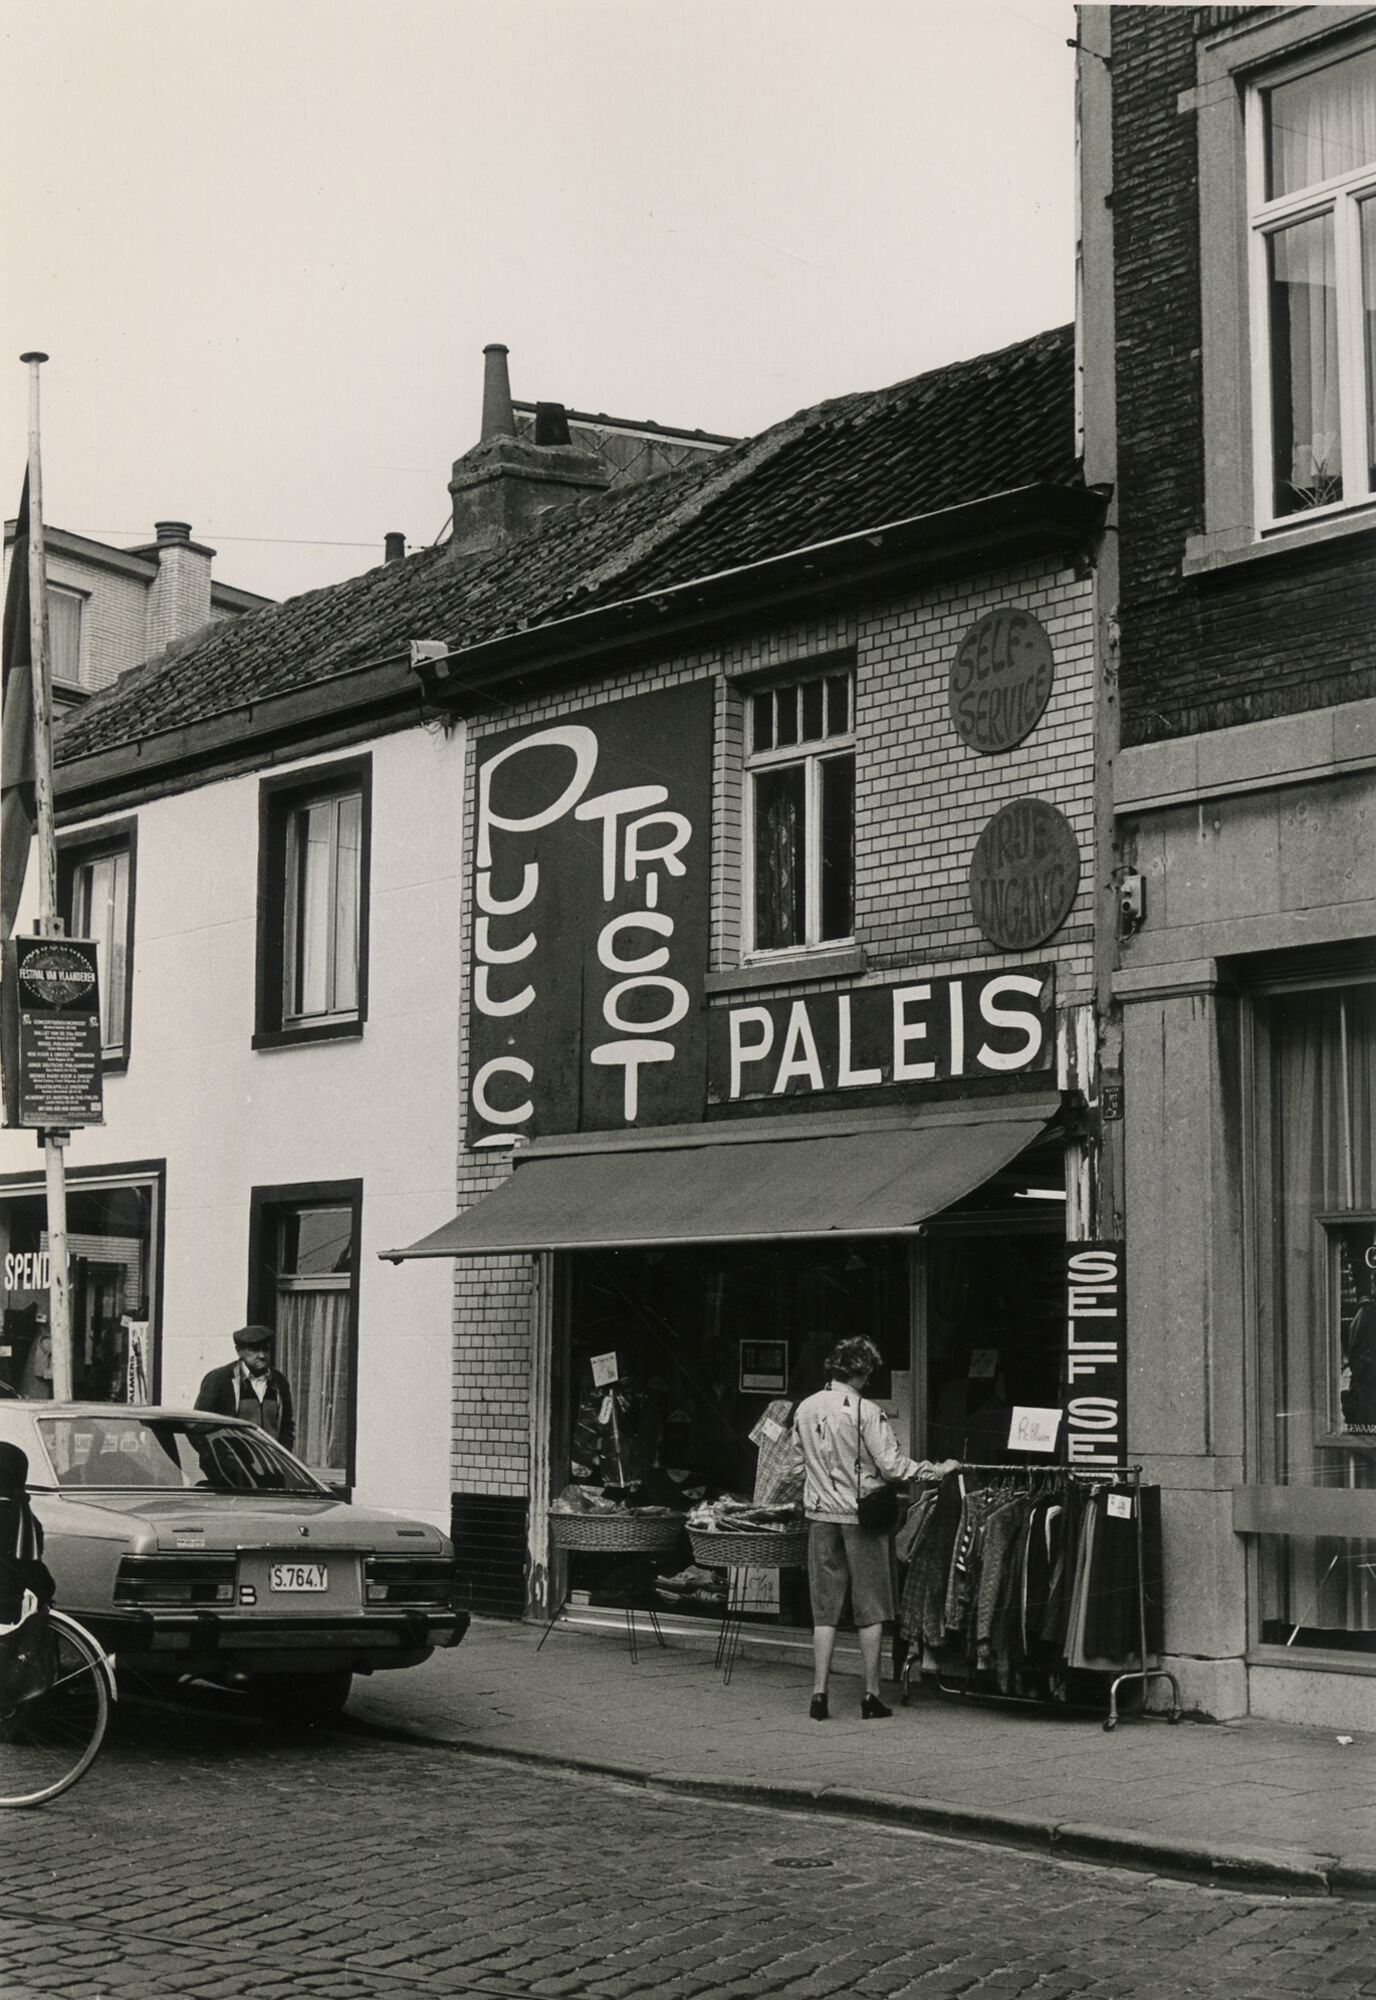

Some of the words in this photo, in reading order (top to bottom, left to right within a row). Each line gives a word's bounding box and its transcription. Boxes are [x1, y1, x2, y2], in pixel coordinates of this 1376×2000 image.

[474, 724, 599, 1018] PULL
[19, 968, 45, 980] FESTIVAL
[45, 969, 58, 981] VAN
[58, 970, 96, 983] VLAANDEREN
[574, 784, 693, 1122] TRICOT
[729, 973, 1044, 1099] PALEIS
[4, 1251, 74, 1291] SPEND
[1067, 1250, 1119, 1385] SELF
[1067, 1396, 1119, 1486] SE
